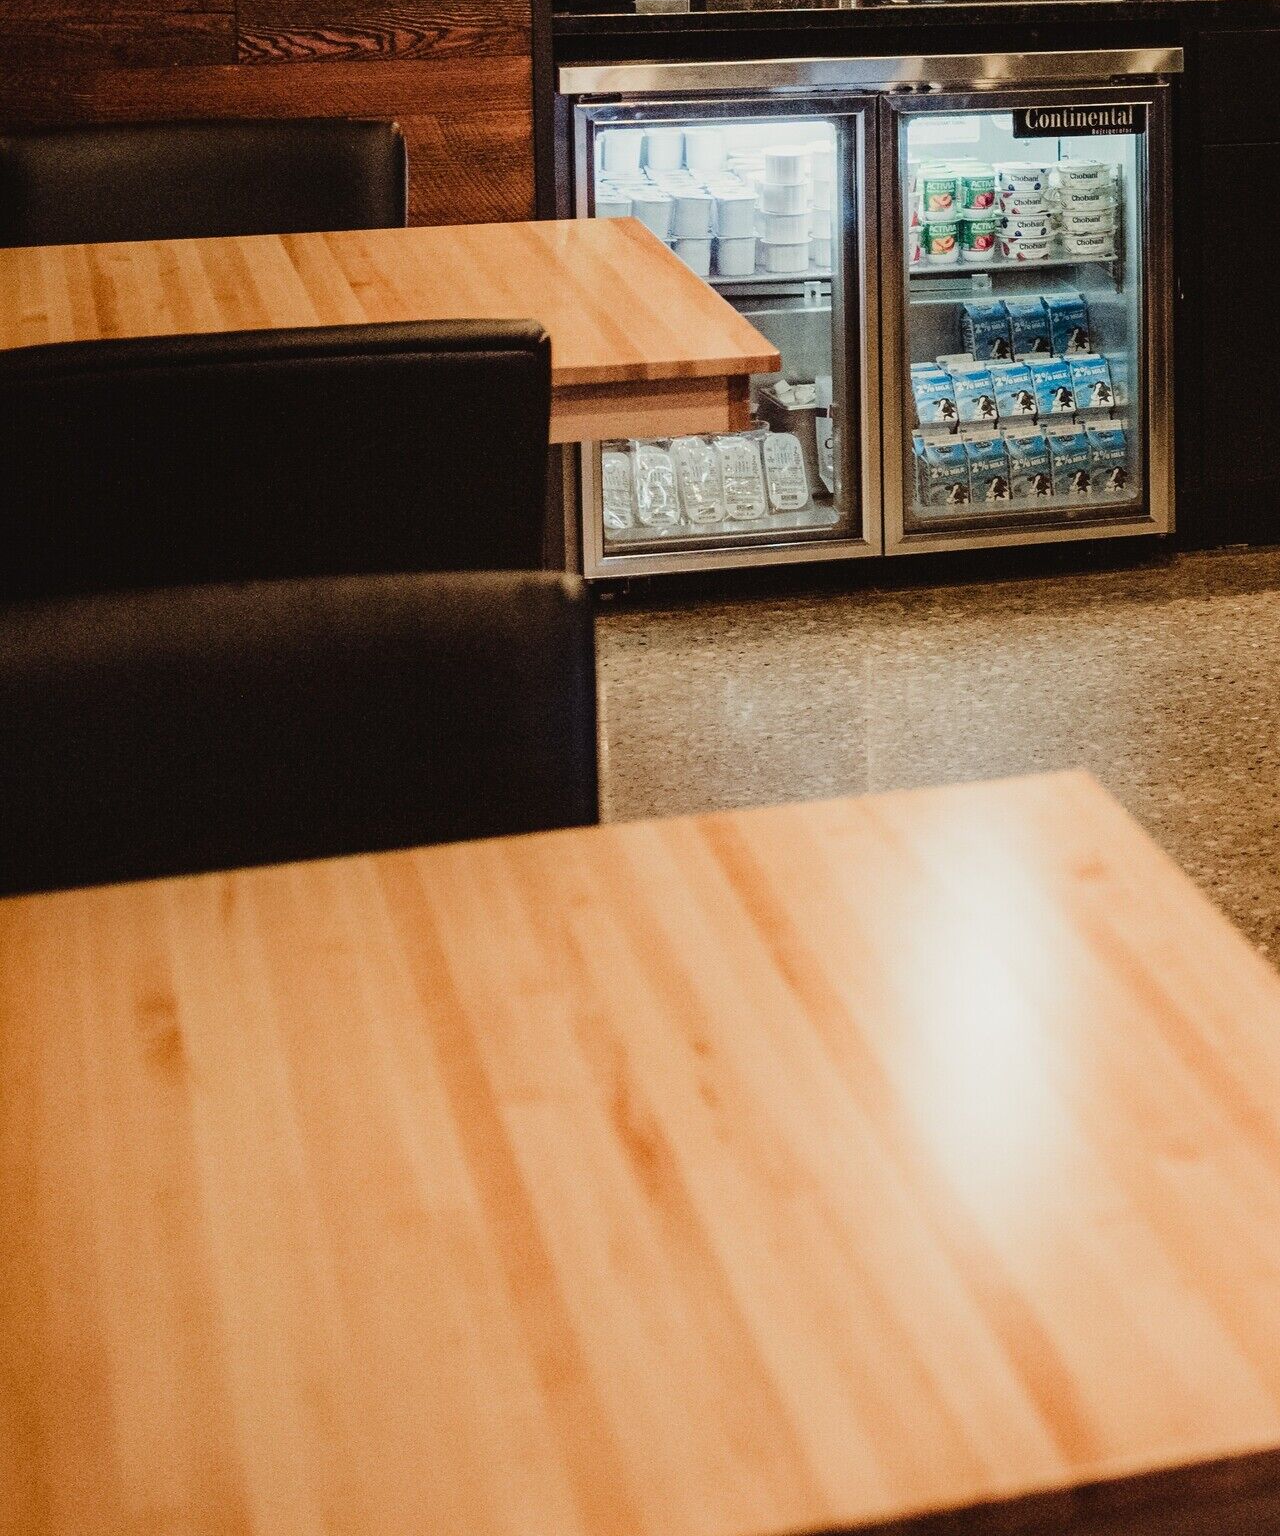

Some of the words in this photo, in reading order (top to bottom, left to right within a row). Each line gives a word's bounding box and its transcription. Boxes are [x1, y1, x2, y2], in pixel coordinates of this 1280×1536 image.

[1025, 106, 1133, 129] Continental
[1011, 174, 1039, 182] Chobani
[1014, 197, 1042, 205] Chobani
[1017, 220, 1045, 228] Chobani
[1072, 216, 1101, 224] Chobani
[1076, 237, 1104, 245] Chobani
[1073, 367, 1091, 377] 2%
[994, 375, 1013, 386] 2%
[1034, 372, 1052, 383] 2%
[916, 384, 935, 394] 2%
[955, 381, 974, 391] 2%
